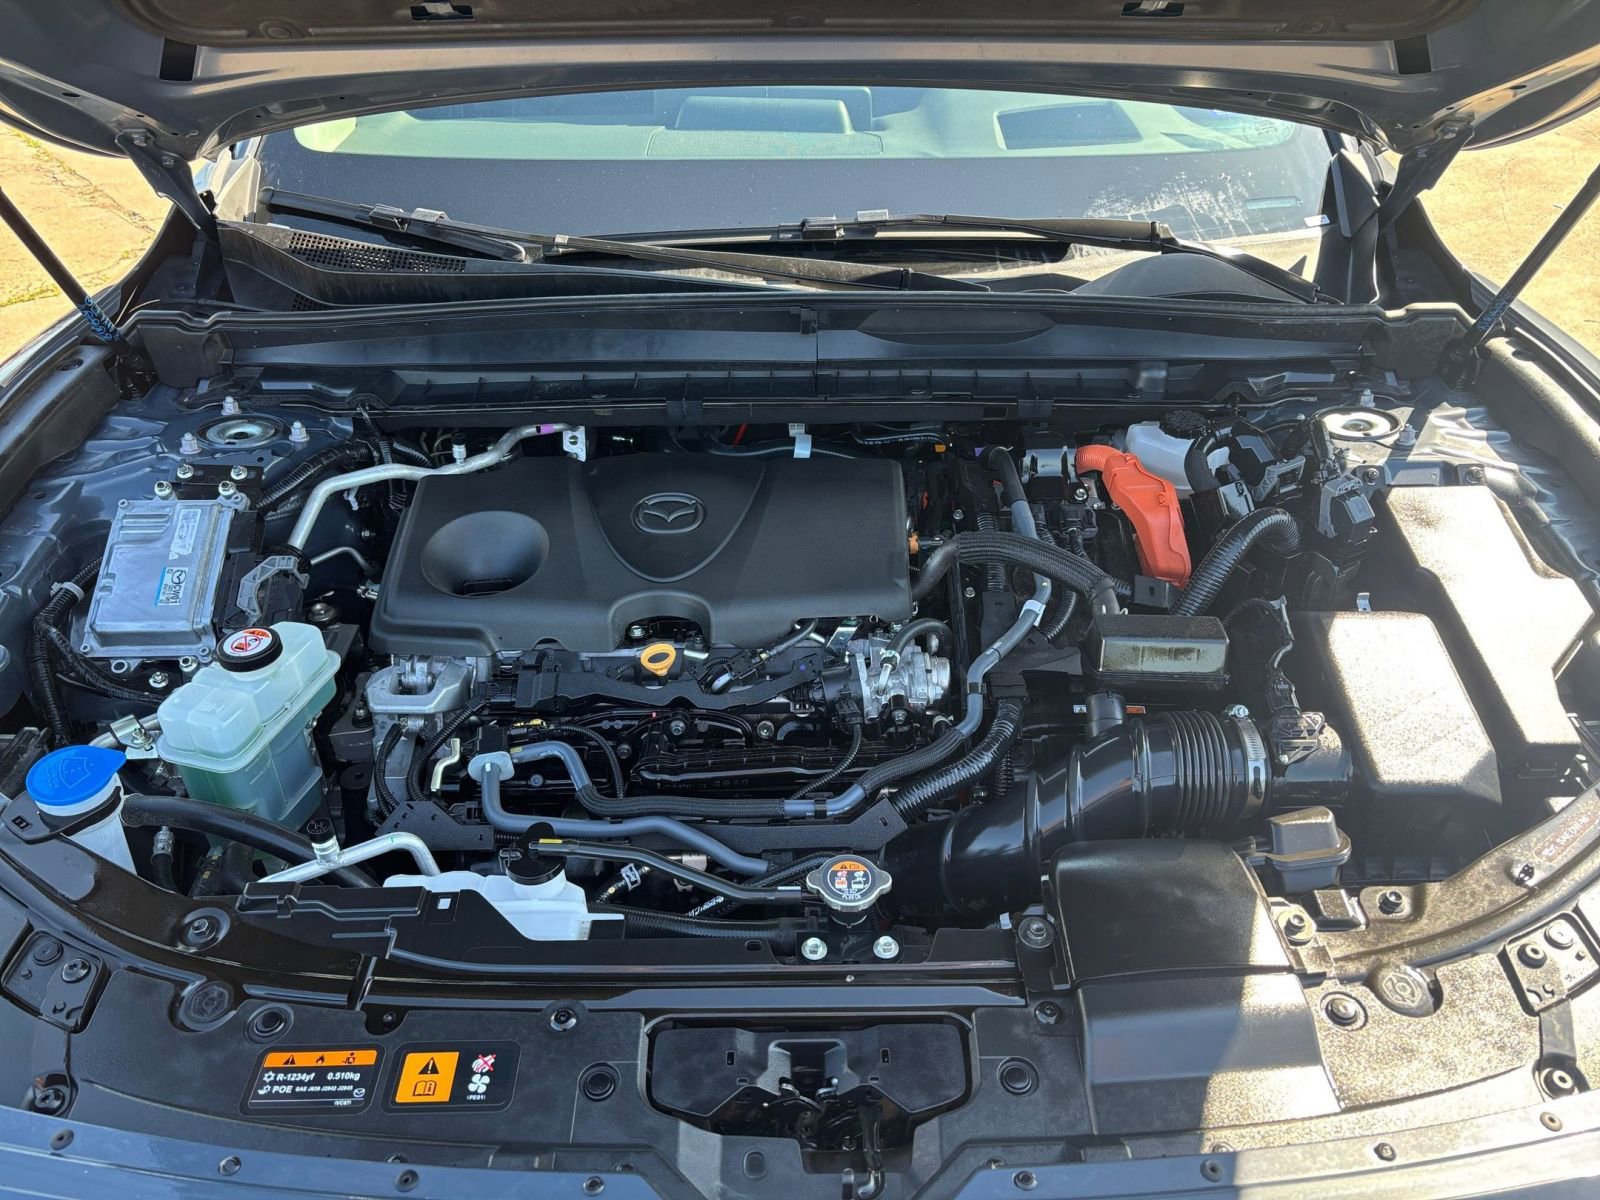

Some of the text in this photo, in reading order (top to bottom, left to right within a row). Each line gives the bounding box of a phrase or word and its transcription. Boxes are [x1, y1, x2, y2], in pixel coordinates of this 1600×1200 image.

[276, 1072, 361, 1082] R-1234yf 0.510kg
[272, 1085, 293, 1094] POE
